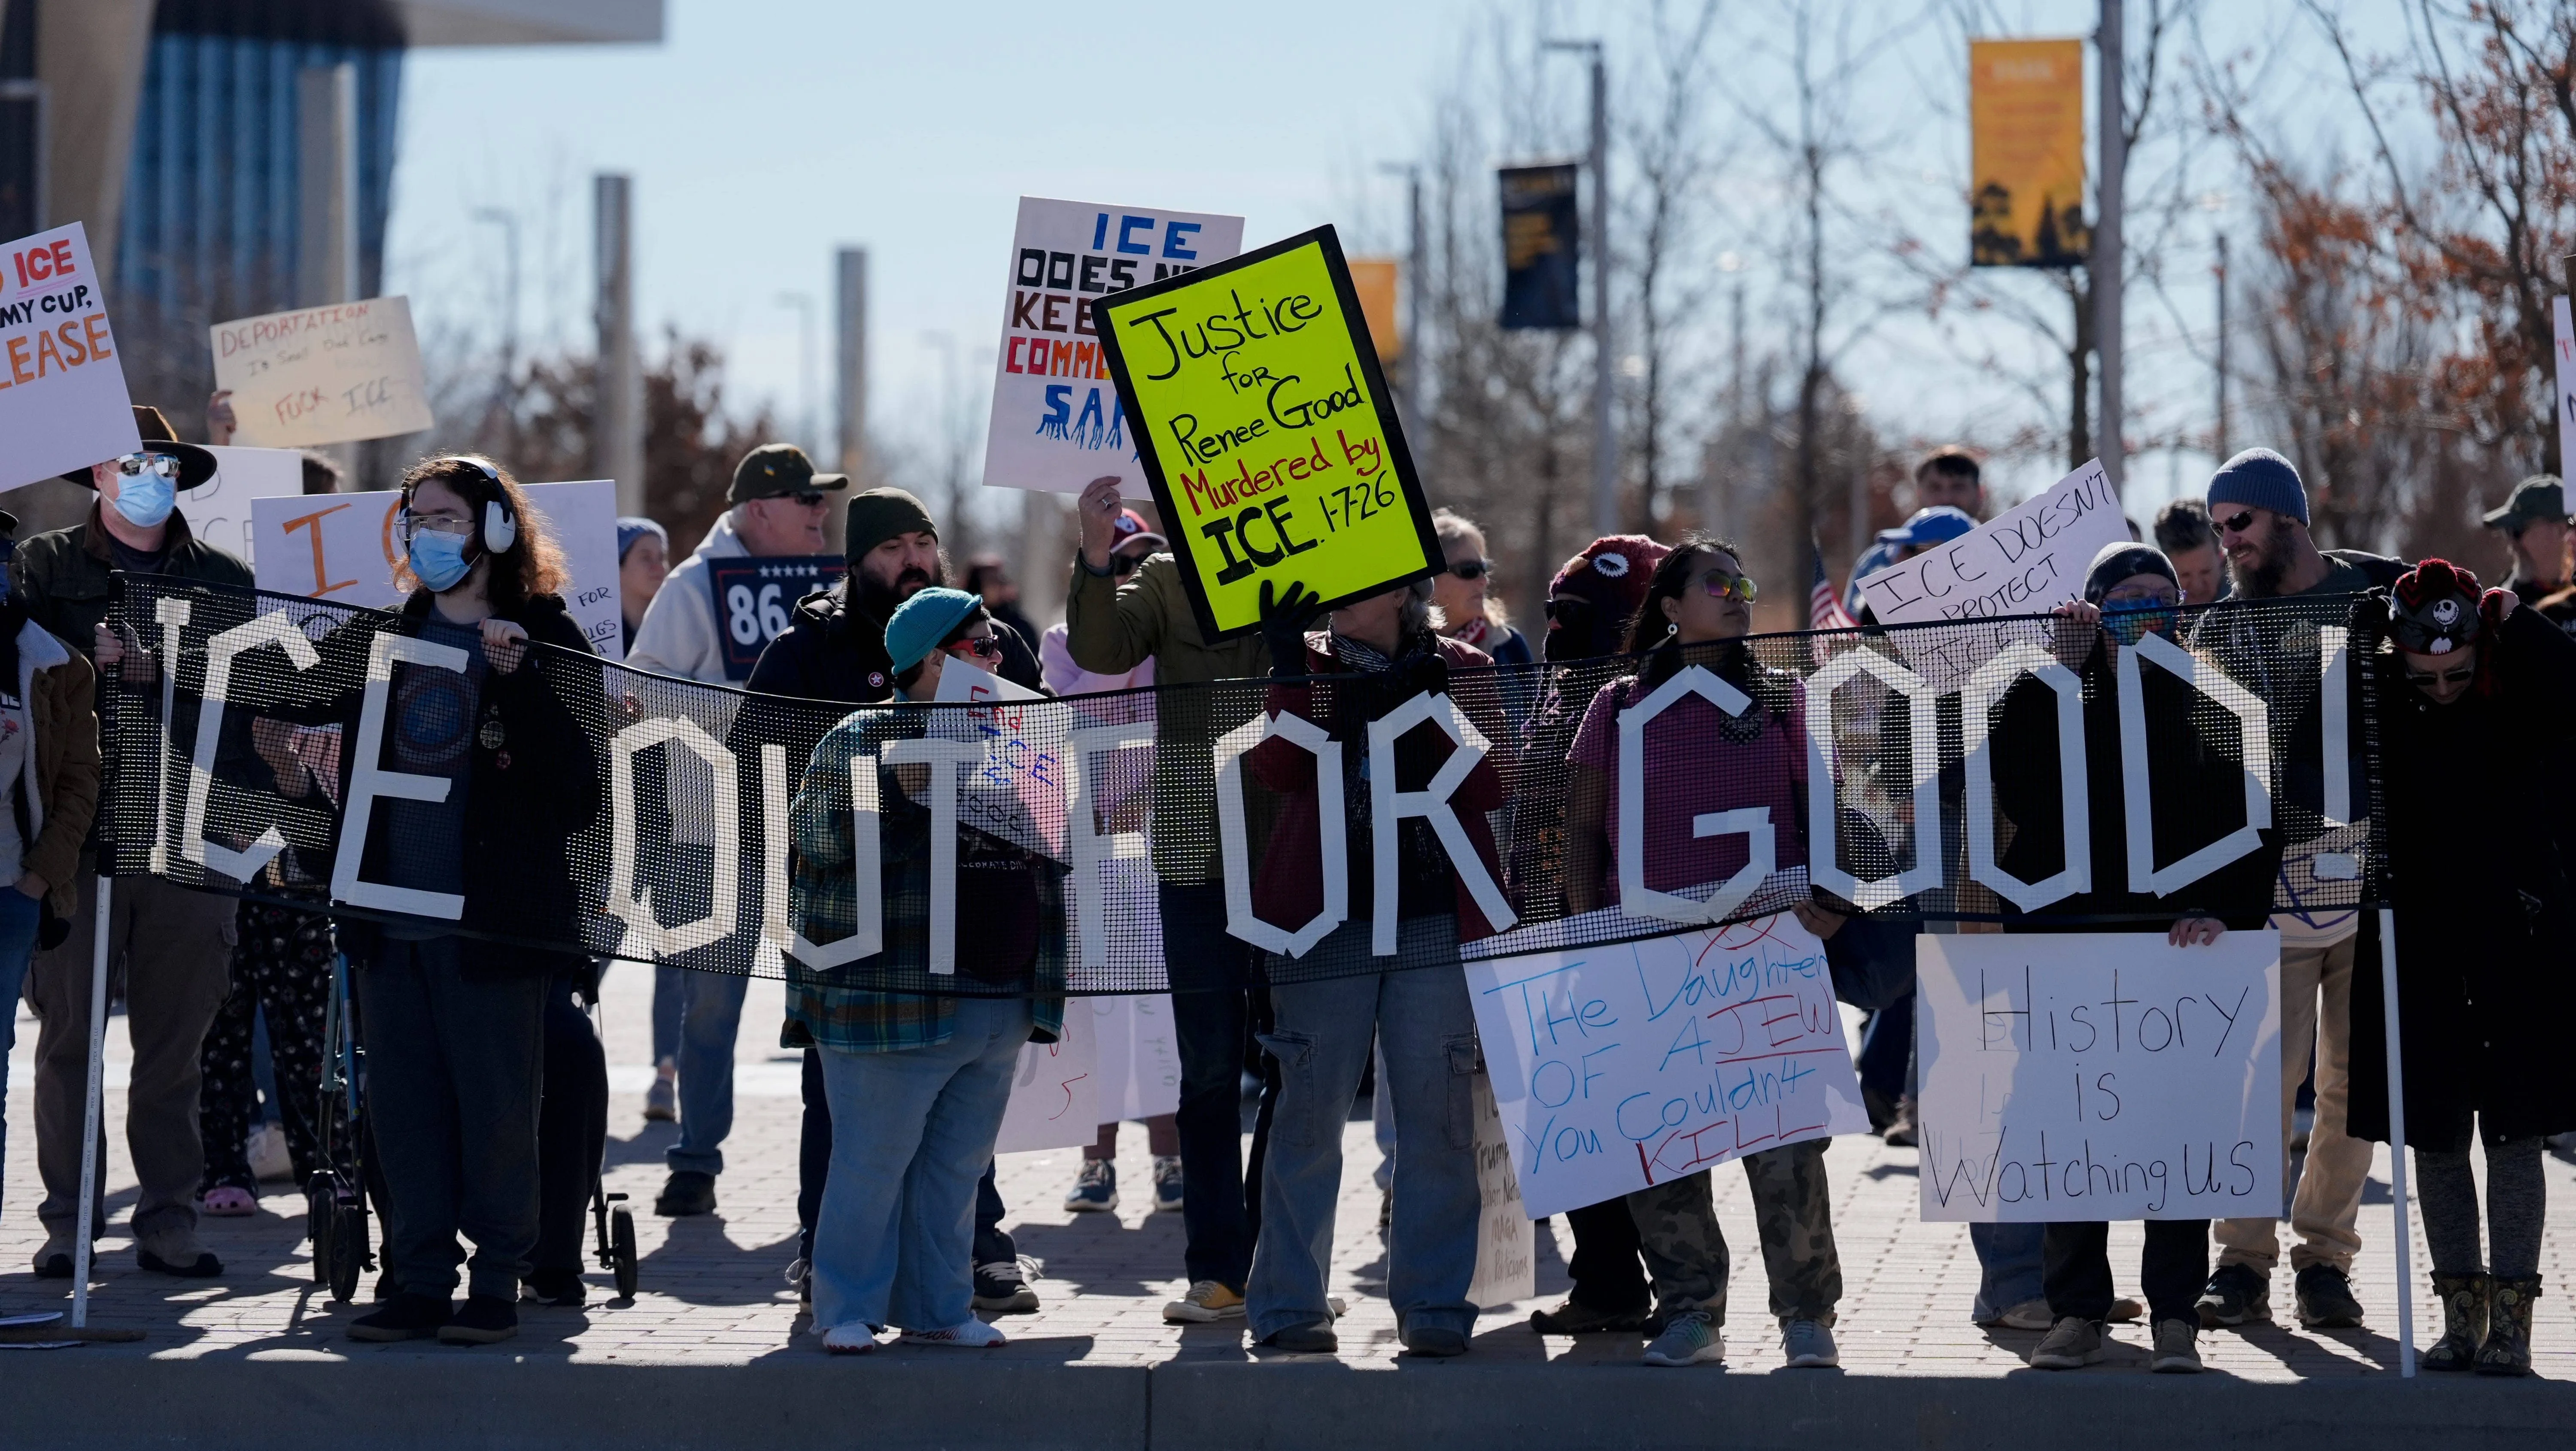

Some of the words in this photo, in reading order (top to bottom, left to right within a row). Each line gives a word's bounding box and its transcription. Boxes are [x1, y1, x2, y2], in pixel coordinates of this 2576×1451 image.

[14, 239, 75, 288] ICE
[1092, 213, 1201, 260] ICE
[1017, 248, 1138, 294] DOES
[0, 299, 34, 328] MY
[41, 285, 92, 313] CUP,
[220, 303, 369, 358] DEPORTATION
[1129, 289, 1322, 381] Justice
[0, 313, 111, 389] EASE
[275, 386, 329, 425] FUCK
[342, 376, 392, 417] ICE
[1169, 413, 1270, 467] Renee
[1267, 362, 1367, 429] Good
[1180, 436, 1333, 515] Murdered
[1337, 429, 1382, 477] by
[1318, 470, 1396, 532] 1-7-26
[1990, 470, 2109, 563] DOESN'T
[578, 587, 612, 607] FOR
[727, 583, 788, 646] 86
[1940, 552, 2059, 619] PROTECT
[968, 686, 1023, 734] End
[149, 597, 469, 920] ICE
[607, 714, 990, 974] OUT
[1065, 690, 1519, 968] FOR
[1616, 625, 2359, 923] GOOD!
[1981, 965, 2249, 1057] History
[1532, 1044, 1621, 1108] OF
[1659, 1017, 1712, 1072] A
[1707, 982, 1832, 1055] JEW
[2075, 1063, 2120, 1122] is
[1515, 1115, 1603, 1174] You
[1637, 1104, 1828, 1186] KILL
[1923, 1121, 2168, 1211] Watching
